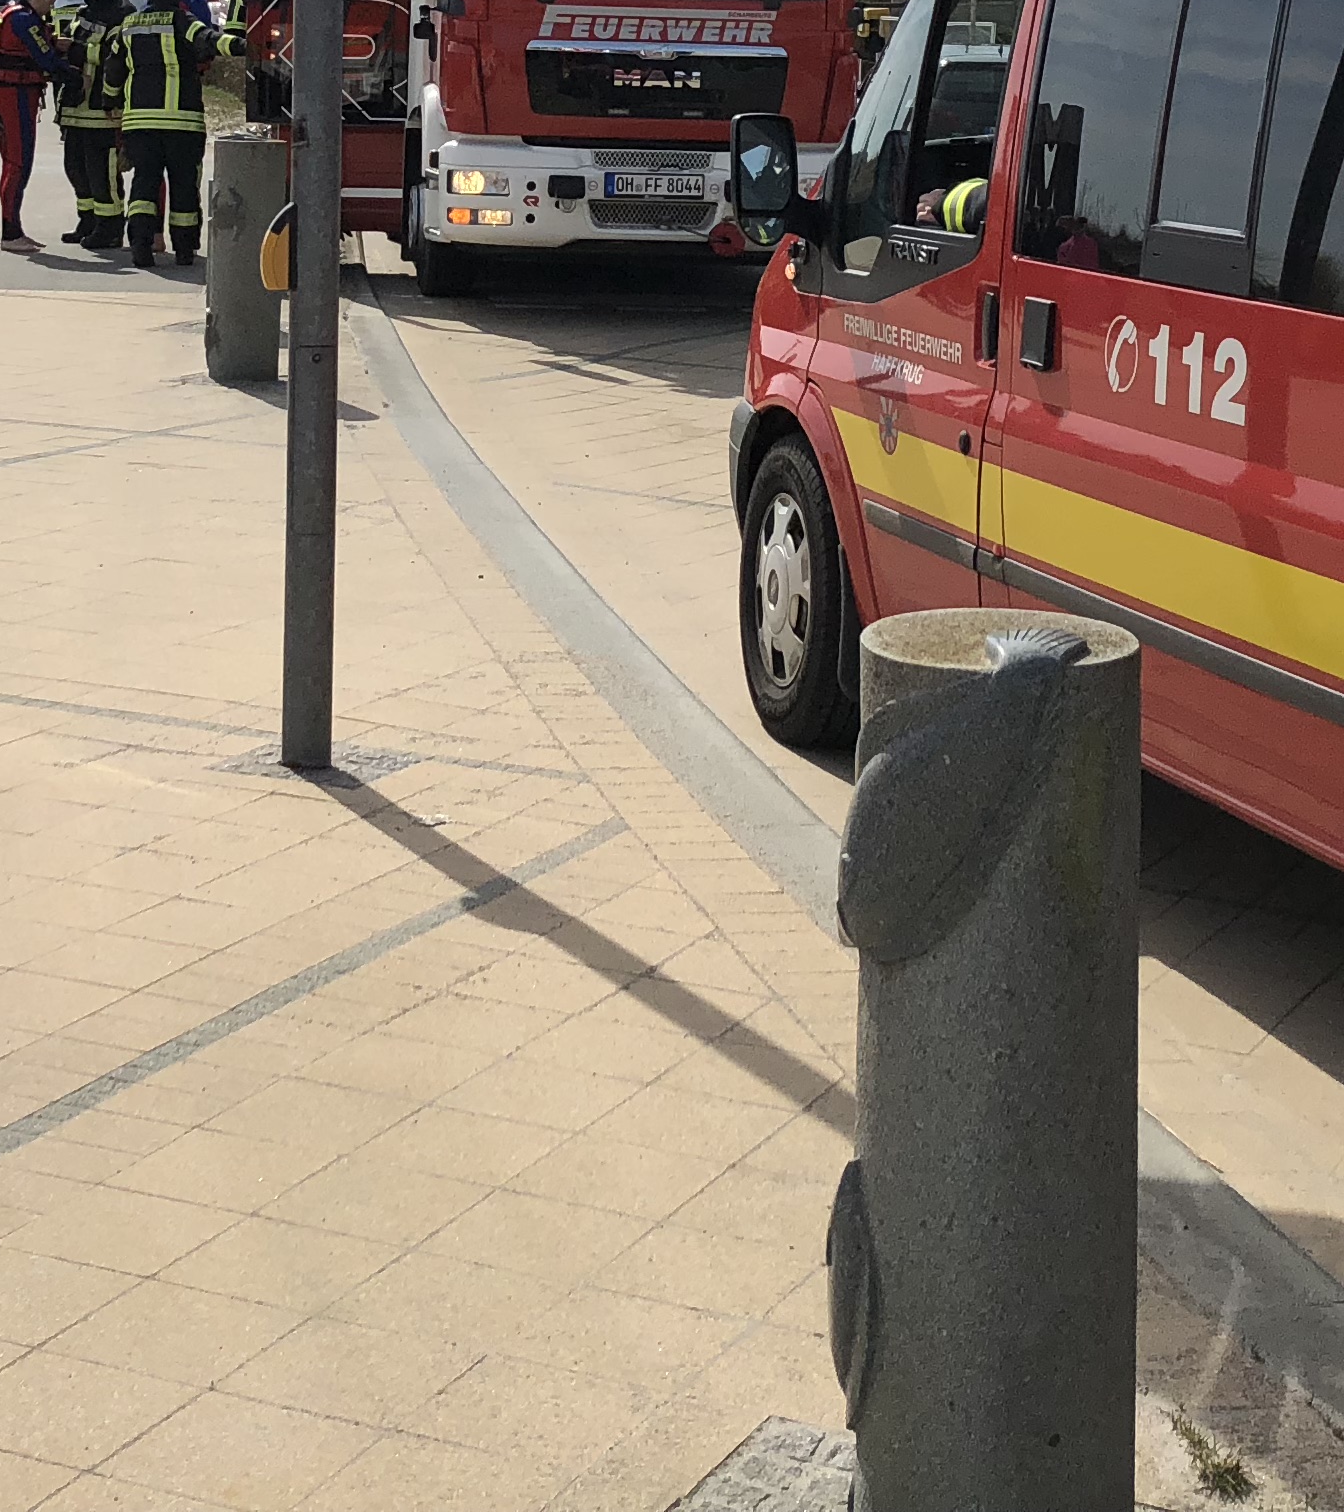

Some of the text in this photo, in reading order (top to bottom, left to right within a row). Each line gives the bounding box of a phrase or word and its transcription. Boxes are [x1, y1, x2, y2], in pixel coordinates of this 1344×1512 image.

[539, 4, 777, 43] FEUERWEHR
[613, 69, 702, 89] MAN
[616, 176, 702, 194] OH FF 8044
[887, 238, 941, 266] TRANSIT
[844, 313, 963, 365] FREIWILLIGE FEUERWEHR
[871, 352, 926, 386] HAFFKRUG
[1148, 323, 1248, 427] 112
